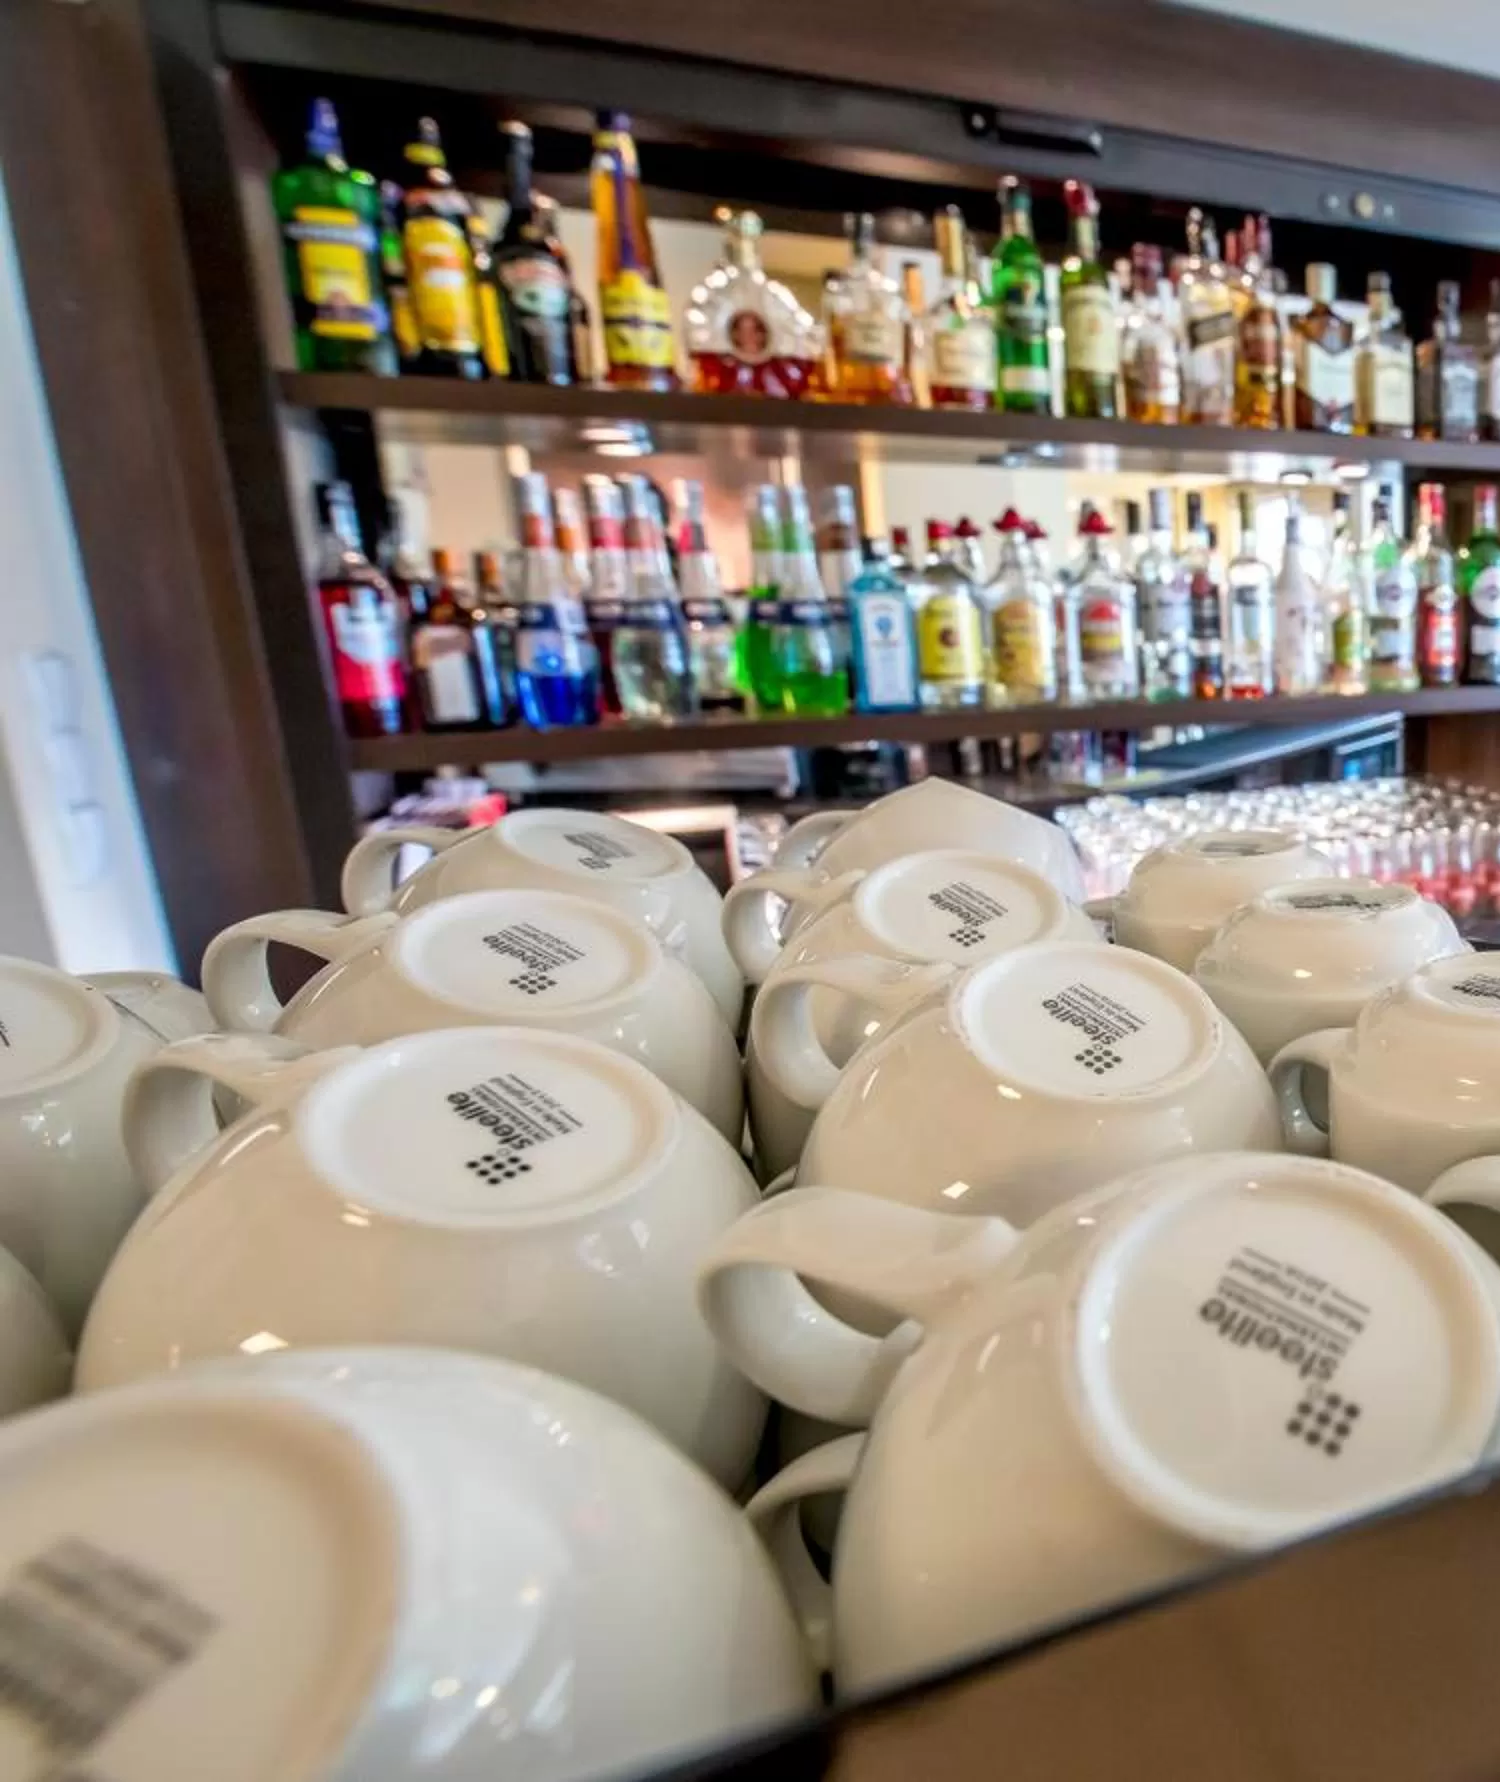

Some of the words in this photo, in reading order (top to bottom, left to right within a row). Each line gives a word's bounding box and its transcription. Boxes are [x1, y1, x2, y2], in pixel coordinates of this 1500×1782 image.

[1042, 999, 1118, 1045] steelite
[446, 1090, 536, 1151] steelite
[1198, 1297, 1339, 1380] steelite
